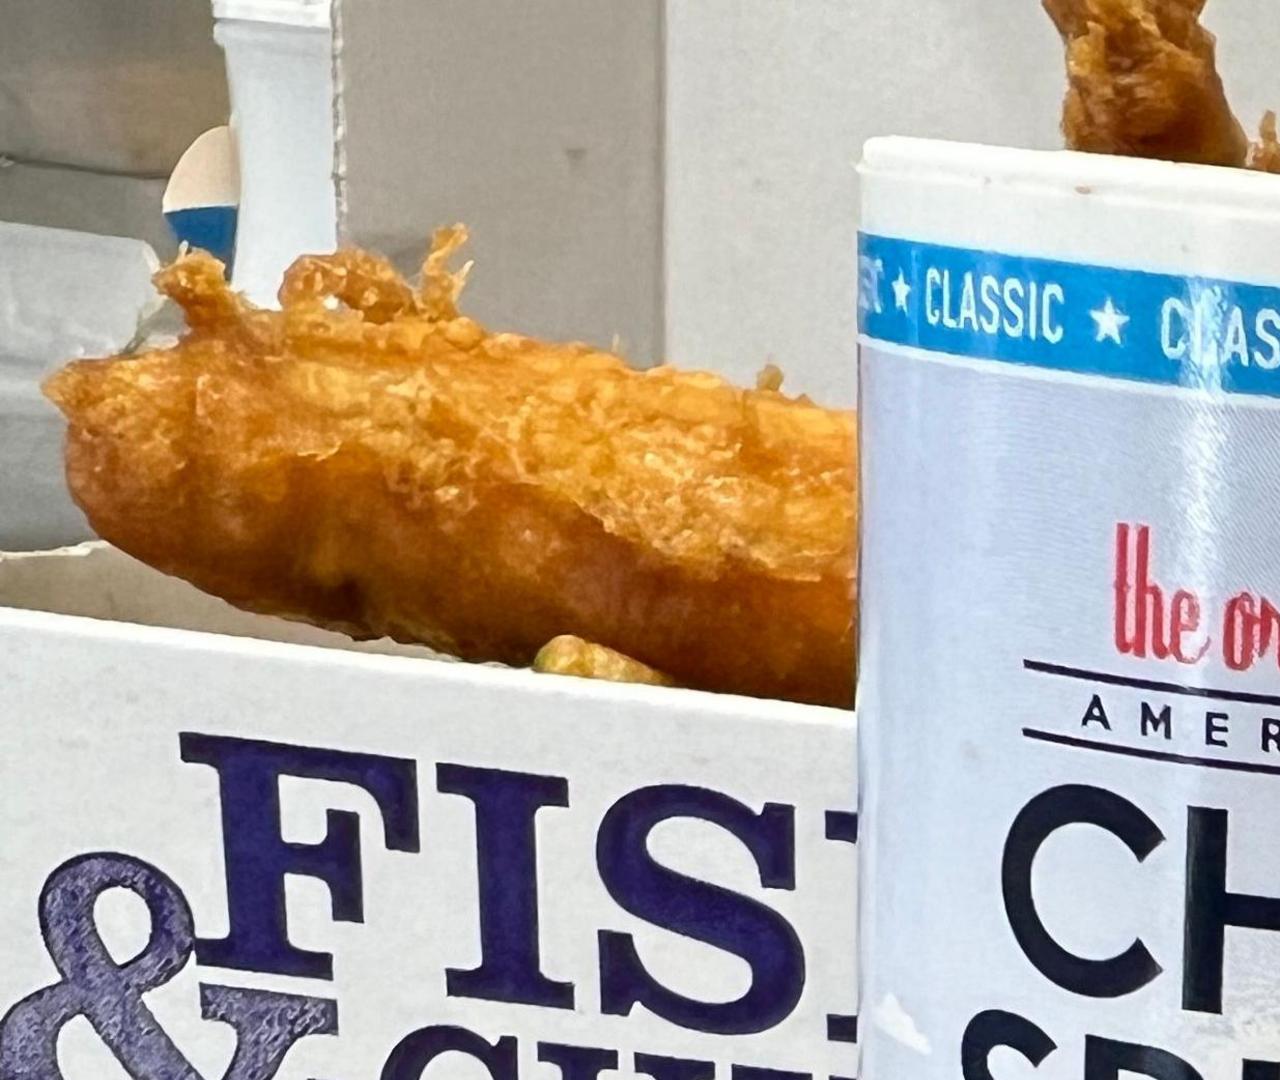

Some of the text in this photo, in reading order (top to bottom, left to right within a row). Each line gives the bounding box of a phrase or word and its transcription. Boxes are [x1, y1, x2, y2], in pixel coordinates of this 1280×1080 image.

[925, 266, 1065, 344] CLASSIC
[1113, 522, 1212, 664] the
[179, 731, 857, 1036] FIS
